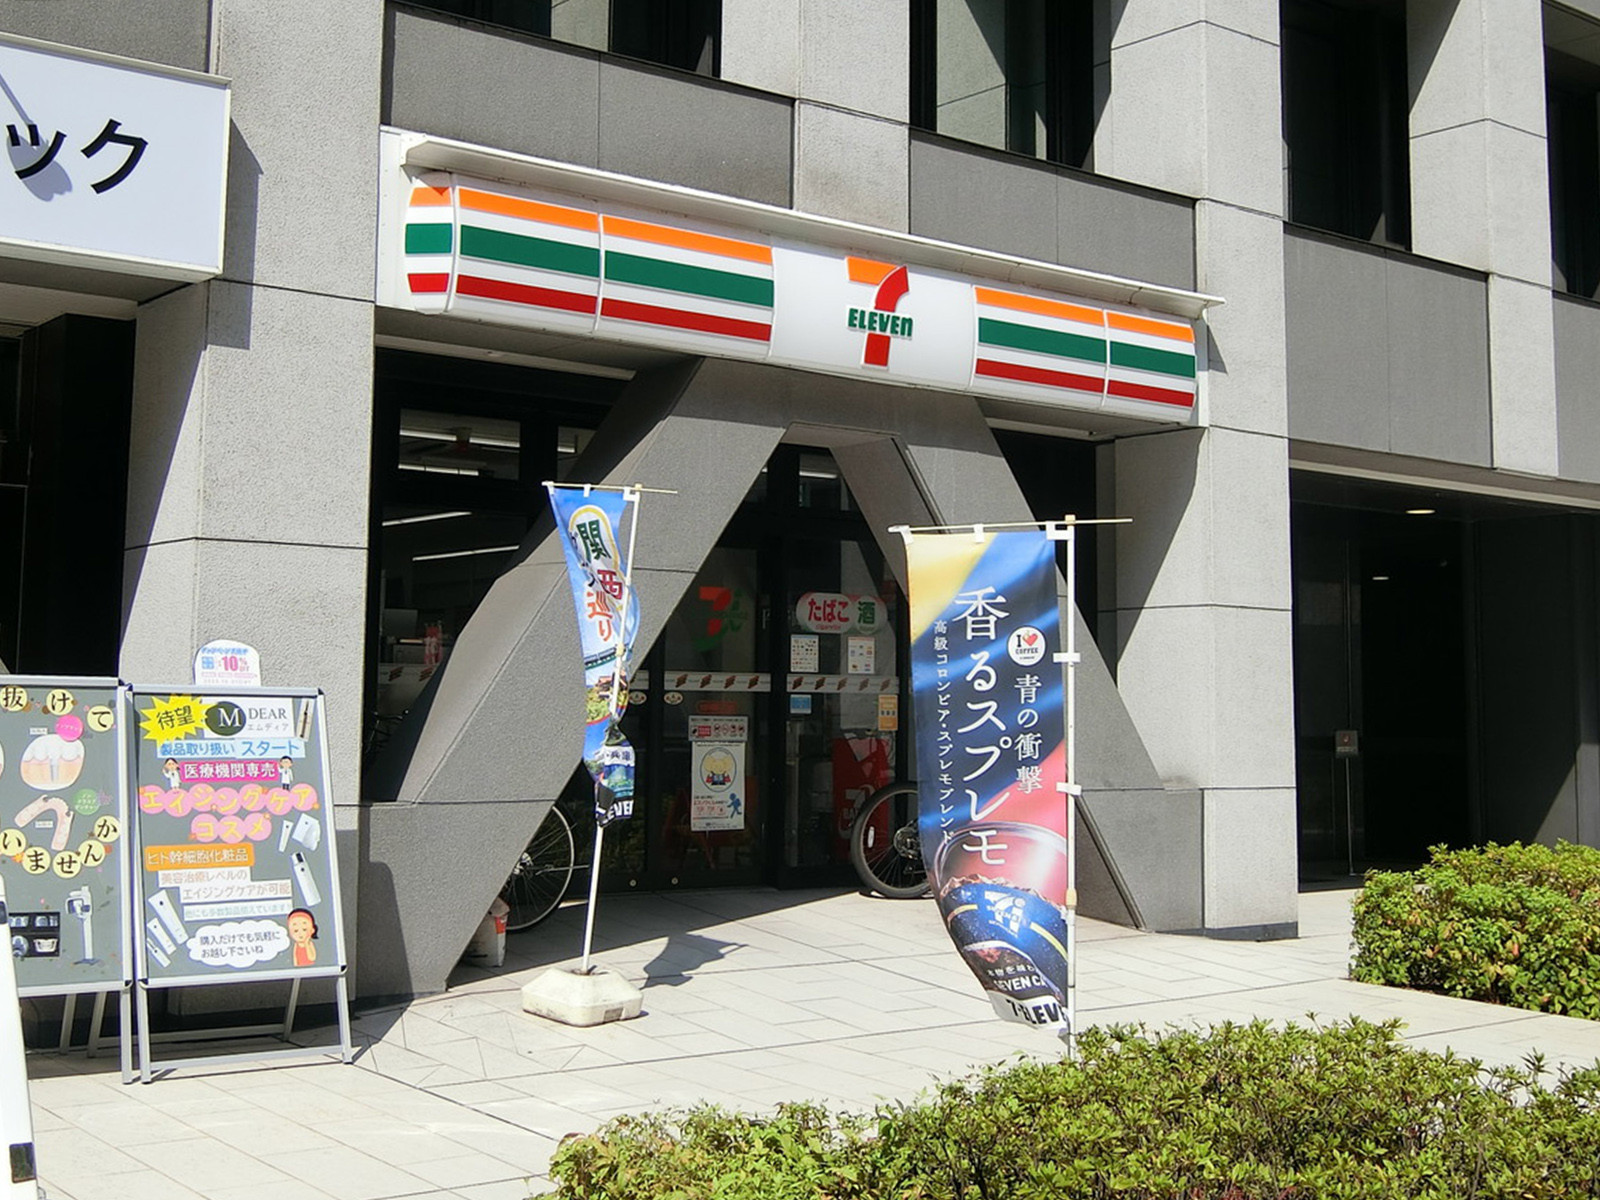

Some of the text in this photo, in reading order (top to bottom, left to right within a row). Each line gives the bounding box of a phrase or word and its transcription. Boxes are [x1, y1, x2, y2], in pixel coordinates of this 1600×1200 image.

[6, 118, 149, 194] ック
[808, 598, 876, 625] たばこ 酒
[156, 706, 196, 730] 待望
[219, 707, 287, 728] M DEAR
[952, 586, 1013, 866] 香るスプレモ
[1014, 674, 1044, 794] 青の衝撃
[160, 740, 300, 757] 製品取り扱い スタート
[184, 761, 276, 779] 医療機関専売
[143, 787, 312, 813] エイジングケア
[196, 818, 265, 838] コスメ
[148, 848, 248, 865] ヒト幹細胞化粧品
[183, 882, 290, 900] エイジングケアが可能
